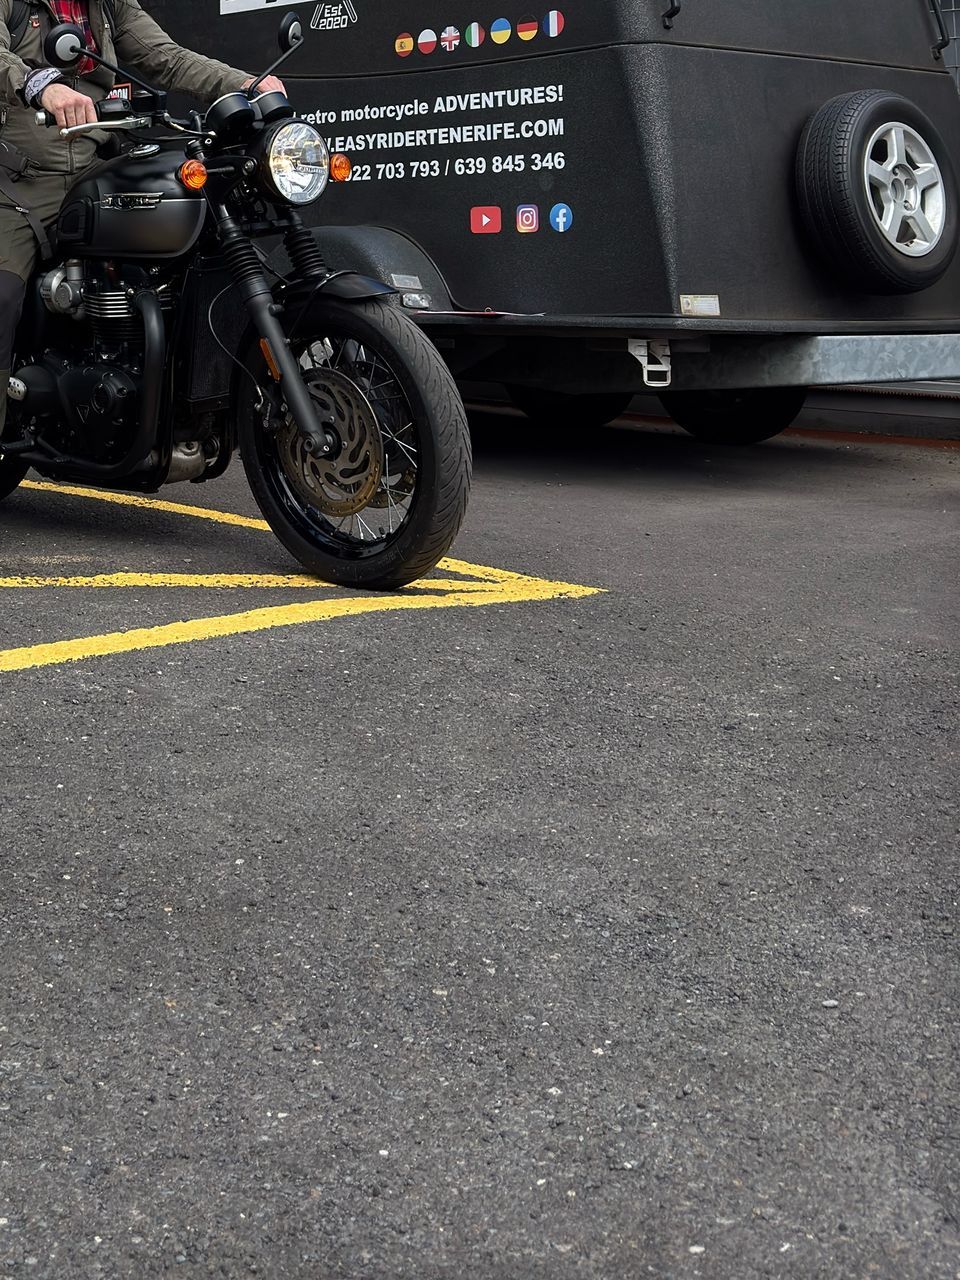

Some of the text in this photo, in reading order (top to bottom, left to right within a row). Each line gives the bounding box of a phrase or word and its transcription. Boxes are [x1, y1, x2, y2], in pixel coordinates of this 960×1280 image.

[324, 3, 342, 17] Est
[319, 15, 348, 30] 2020
[300, 84, 564, 125] retro motorcycle ADVENTURES!
[376, 162, 405, 180] 703
[409, 160, 440, 178] 793
[444, 159, 450, 176] /
[454, 157, 486, 175] 639
[491, 154, 525, 173] 845
[530, 151, 565, 171] 346
